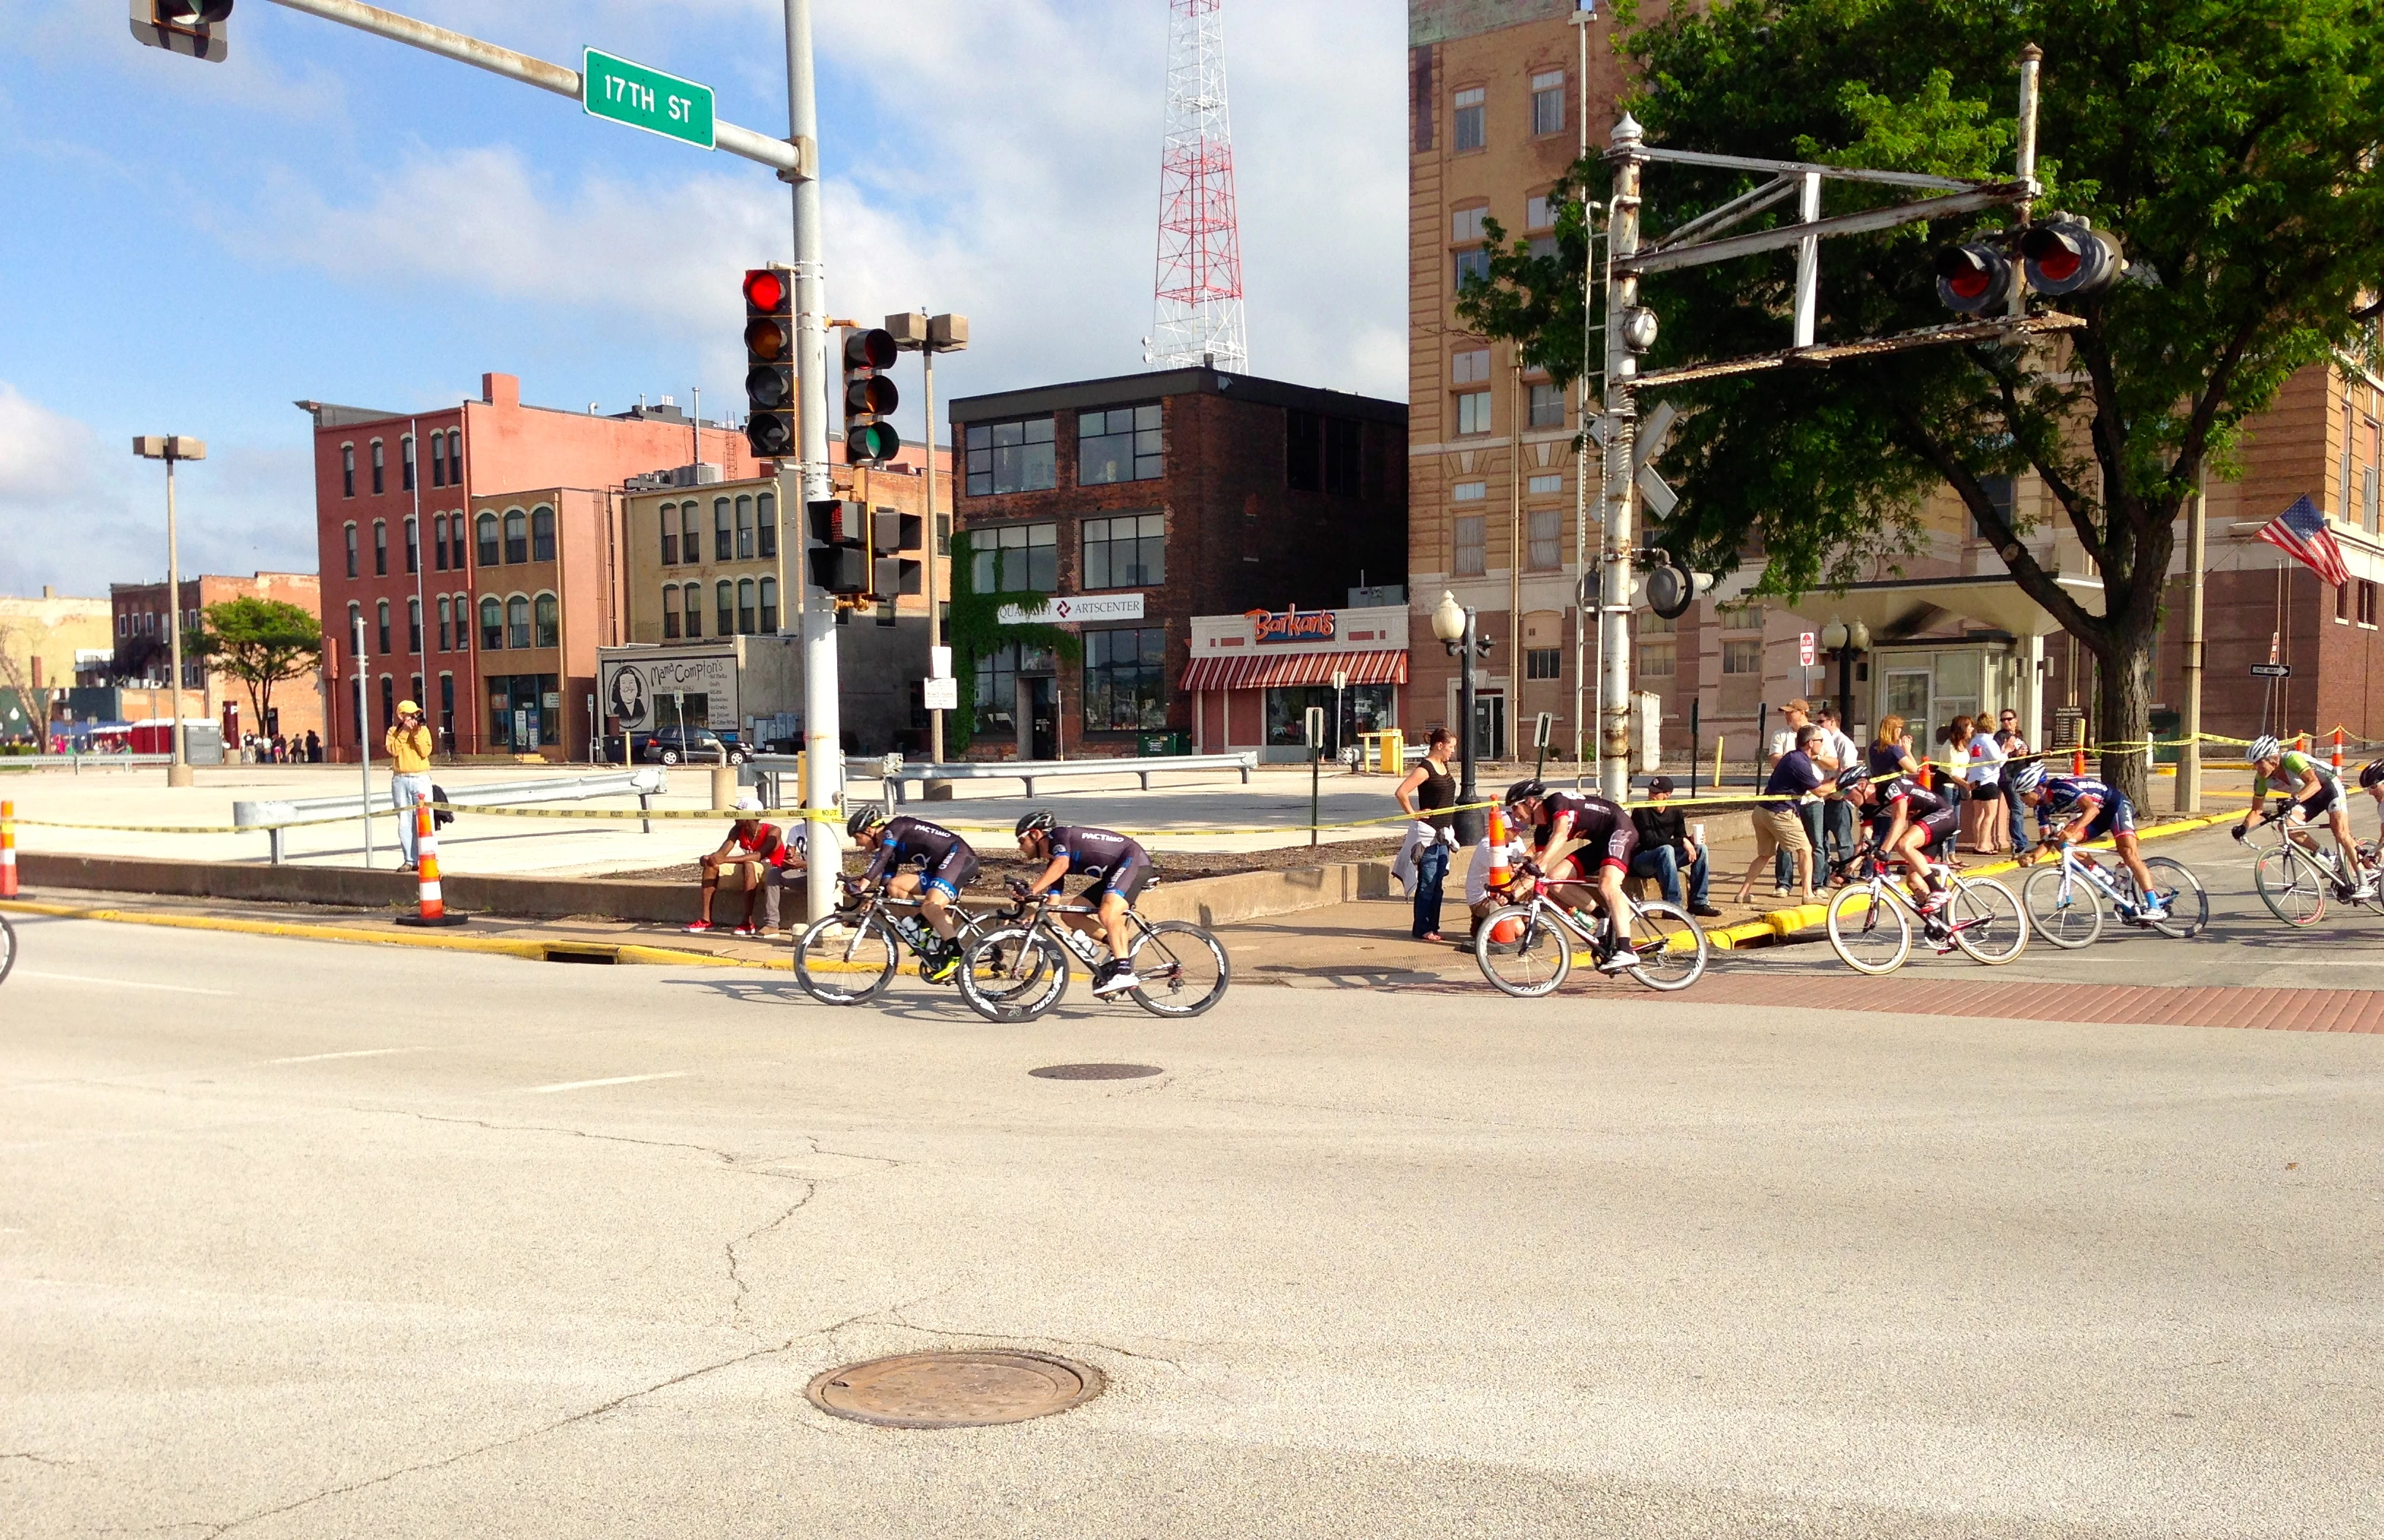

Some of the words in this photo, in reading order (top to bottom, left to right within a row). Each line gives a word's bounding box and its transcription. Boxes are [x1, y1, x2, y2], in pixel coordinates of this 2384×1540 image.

[605, 74, 655, 113] 17TH
[667, 94, 692, 124] ST
[1075, 600, 1140, 615] ARTSCENTER
[1244, 603, 1335, 640] Barkan's
[651, 662, 674, 686] Mama
[675, 660, 723, 683] Compton's
[914, 824, 951, 838] PACTIMO
[1082, 832, 1124, 843] PACTIMO
[1030, 966, 1064, 1014] MERCURY
